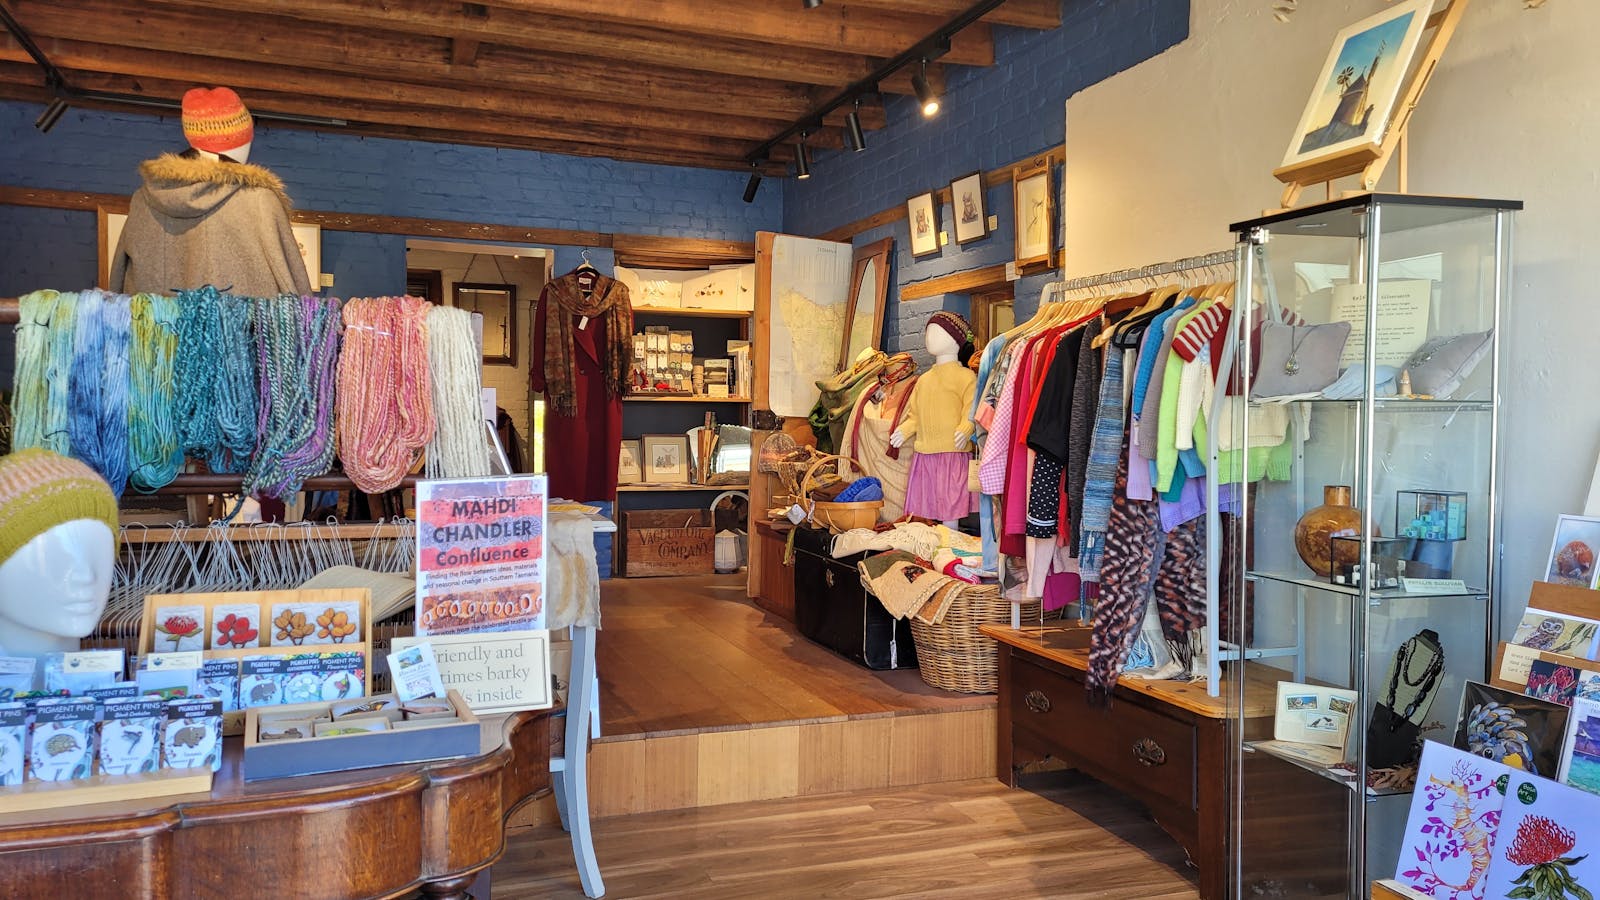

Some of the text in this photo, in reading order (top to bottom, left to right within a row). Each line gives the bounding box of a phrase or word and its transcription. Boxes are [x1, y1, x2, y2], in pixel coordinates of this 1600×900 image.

[452, 498, 516, 517] MAHDI
[432, 520, 532, 543] CHANDLER
[436, 547, 529, 567] Confluence
[658, 541, 709, 560] COMPANY
[460, 569, 472, 577] flow
[473, 567, 497, 576] between
[514, 563, 538, 571] materials
[423, 582, 434, 590] and
[435, 580, 461, 589] seasonal
[461, 577, 482, 587] change
[489, 573, 514, 582] Southern
[481, 620, 510, 630] celebrated
[434, 643, 523, 664] riendly and
[487, 664, 530, 682] barky
[120, 688, 135, 696] PINS
[477, 685, 523, 703] inside
[39, 703, 95, 714] PIGMENT PINS
[105, 703, 141, 713] PIGMENT
[142, 702, 161, 710] PINS
